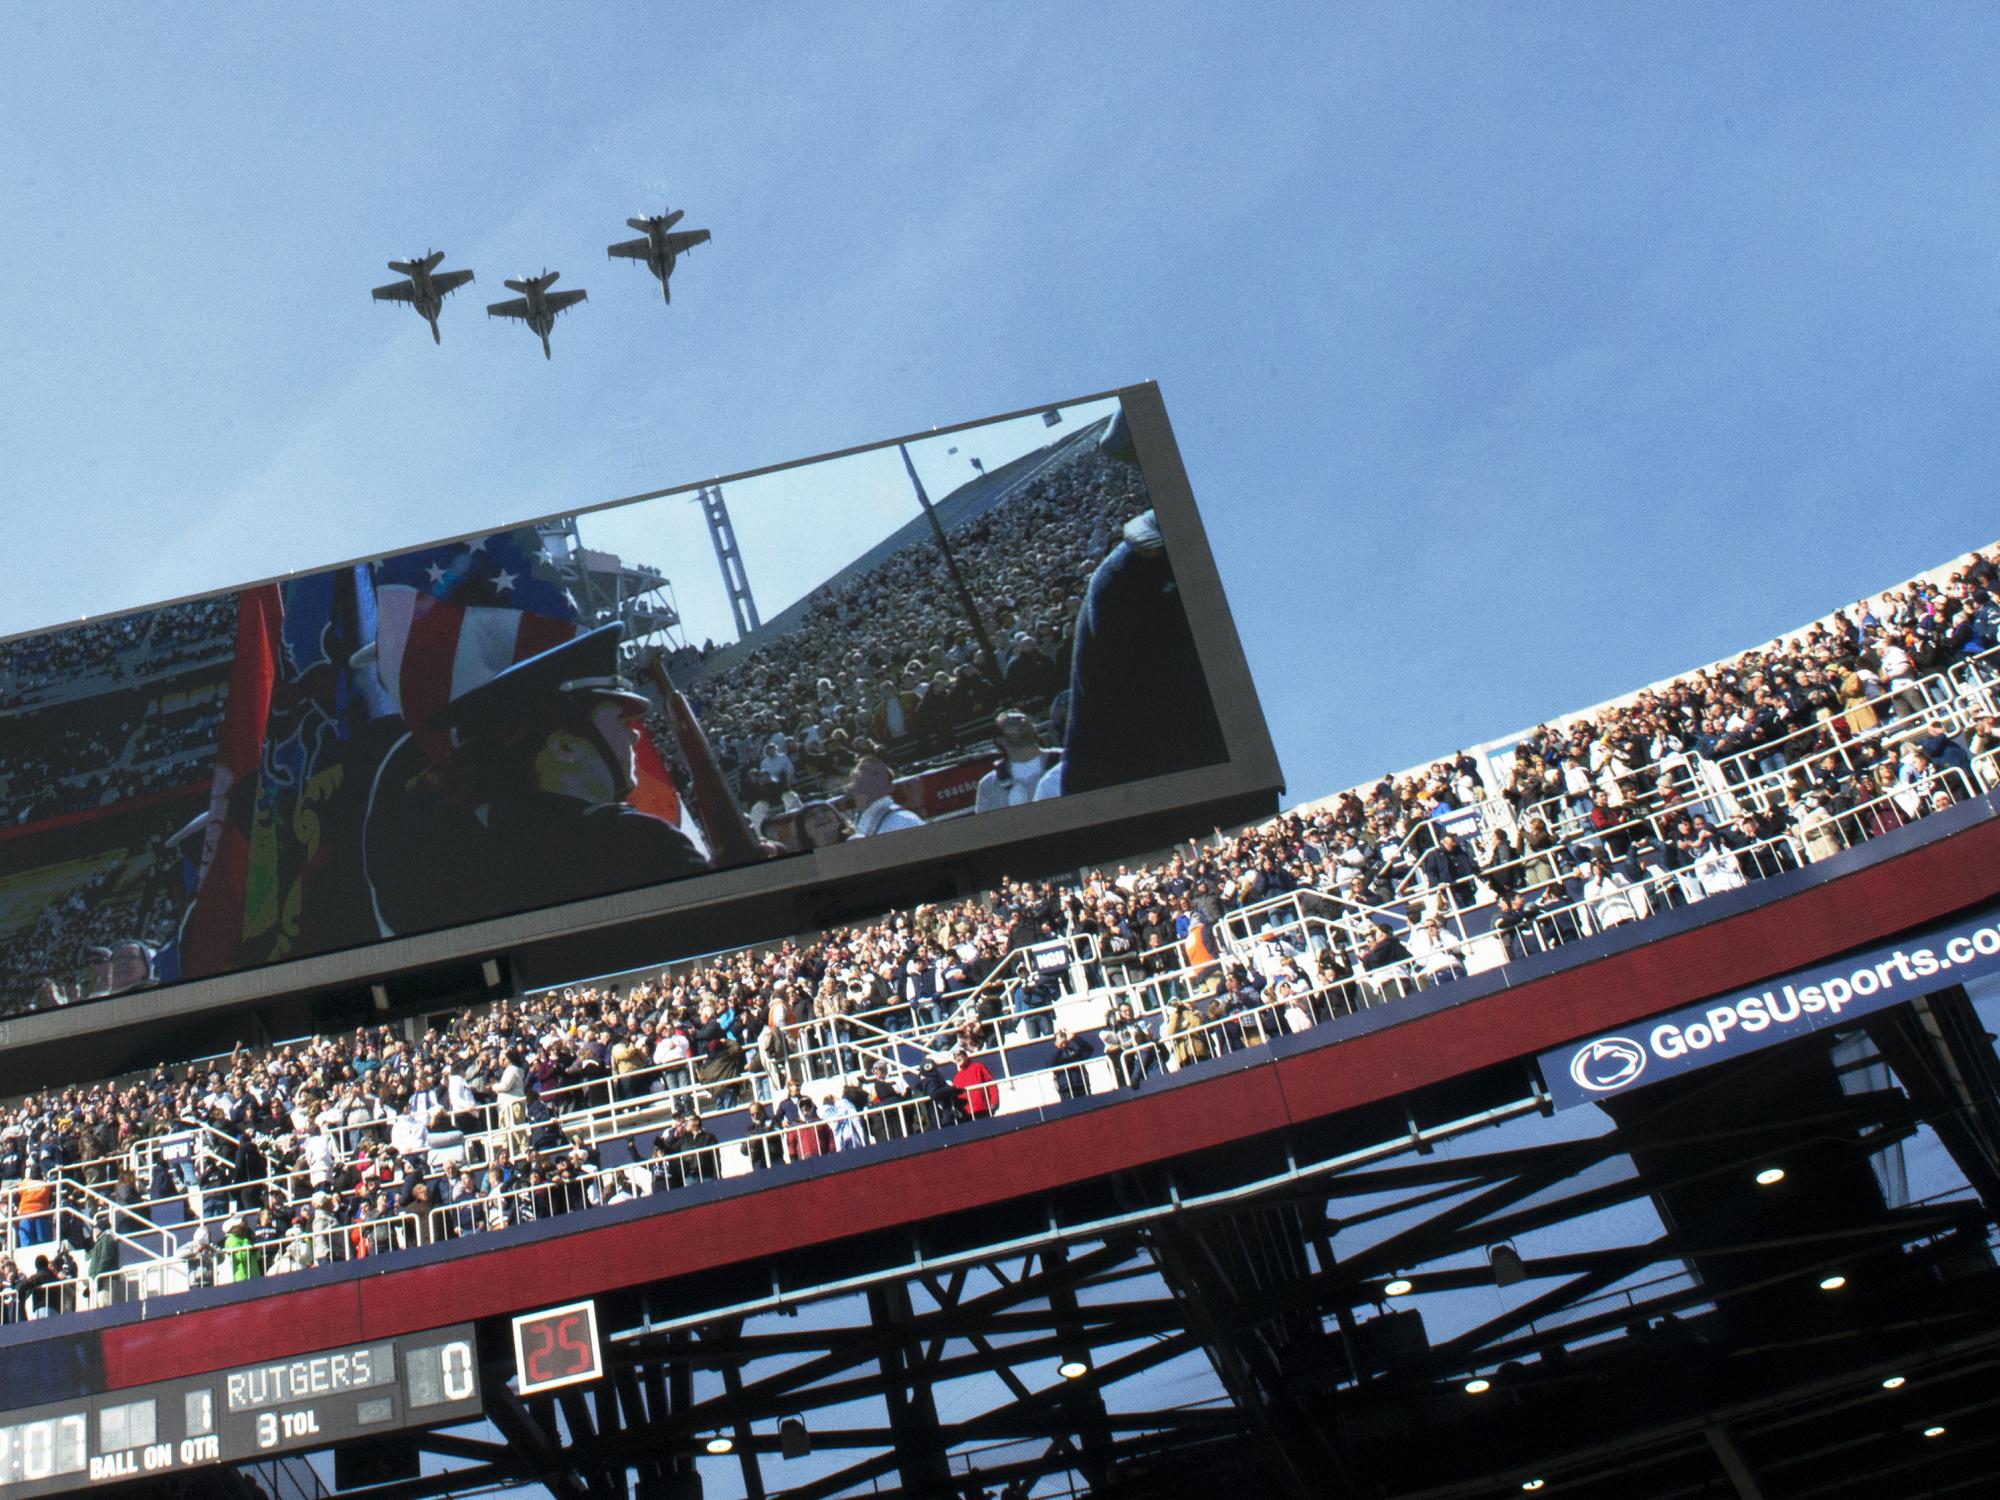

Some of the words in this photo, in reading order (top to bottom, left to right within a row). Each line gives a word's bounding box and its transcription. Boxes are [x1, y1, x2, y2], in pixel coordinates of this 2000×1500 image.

[1649, 923, 2000, 1059] GoPSUsports.co
[442, 1341, 474, 1400] 0
[530, 1317, 589, 1381] 25
[227, 1350, 371, 1409] RUTGERS
[180, 1434, 219, 1465] QTR
[259, 1412, 278, 1448] 3
[281, 1410, 320, 1438] TOL
[90, 1446, 139, 1480] BALL
[143, 1443, 172, 1470] ON
